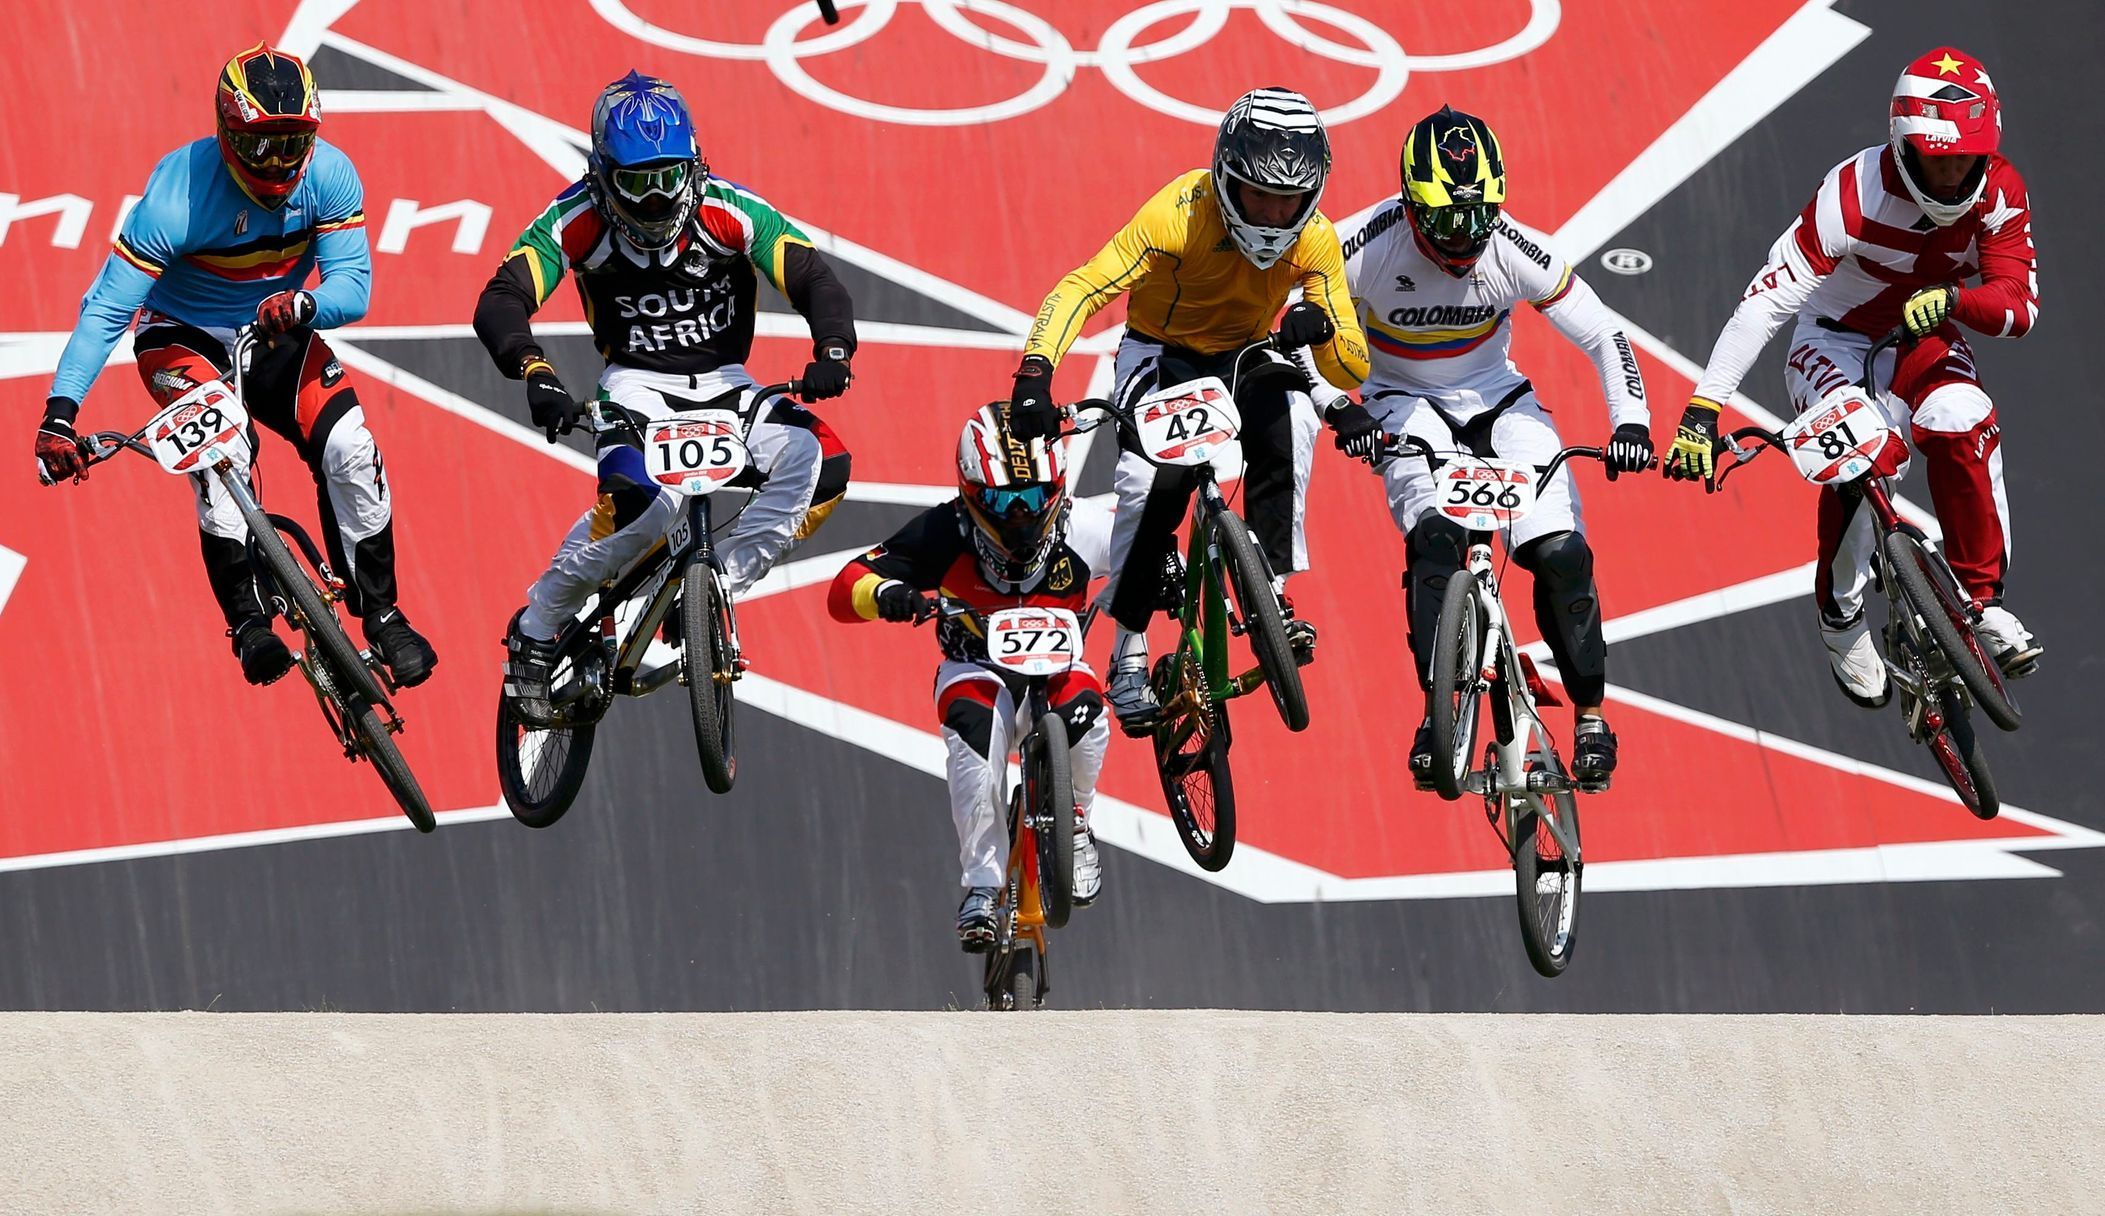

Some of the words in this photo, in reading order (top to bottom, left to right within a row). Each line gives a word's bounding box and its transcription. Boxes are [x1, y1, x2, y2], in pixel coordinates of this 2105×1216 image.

[1925, 132, 1958, 144] LATVIA
[1176, 185, 1202, 208] AUS
[1342, 204, 1406, 262] OLOMBIA
[1498, 217, 1553, 271] OLOMBIA
[615, 274, 731, 318] SOUTH
[628, 295, 736, 353] AFRICA
[1031, 291, 1063, 350] AUSTRALIA
[1388, 304, 1496, 327] COLOMBIA
[152, 371, 194, 391] BELGIUM
[1612, 329, 1644, 400] COLOMBIA
[166, 407, 223, 456] 139
[1166, 407, 1215, 442] 42
[1677, 427, 1711, 448] FOX
[1818, 420, 1858, 460] 81
[658, 436, 732, 471] 105
[1447, 480, 1521, 509] 566
[671, 523, 689, 549] 105
[1001, 630, 1071, 654] 572
